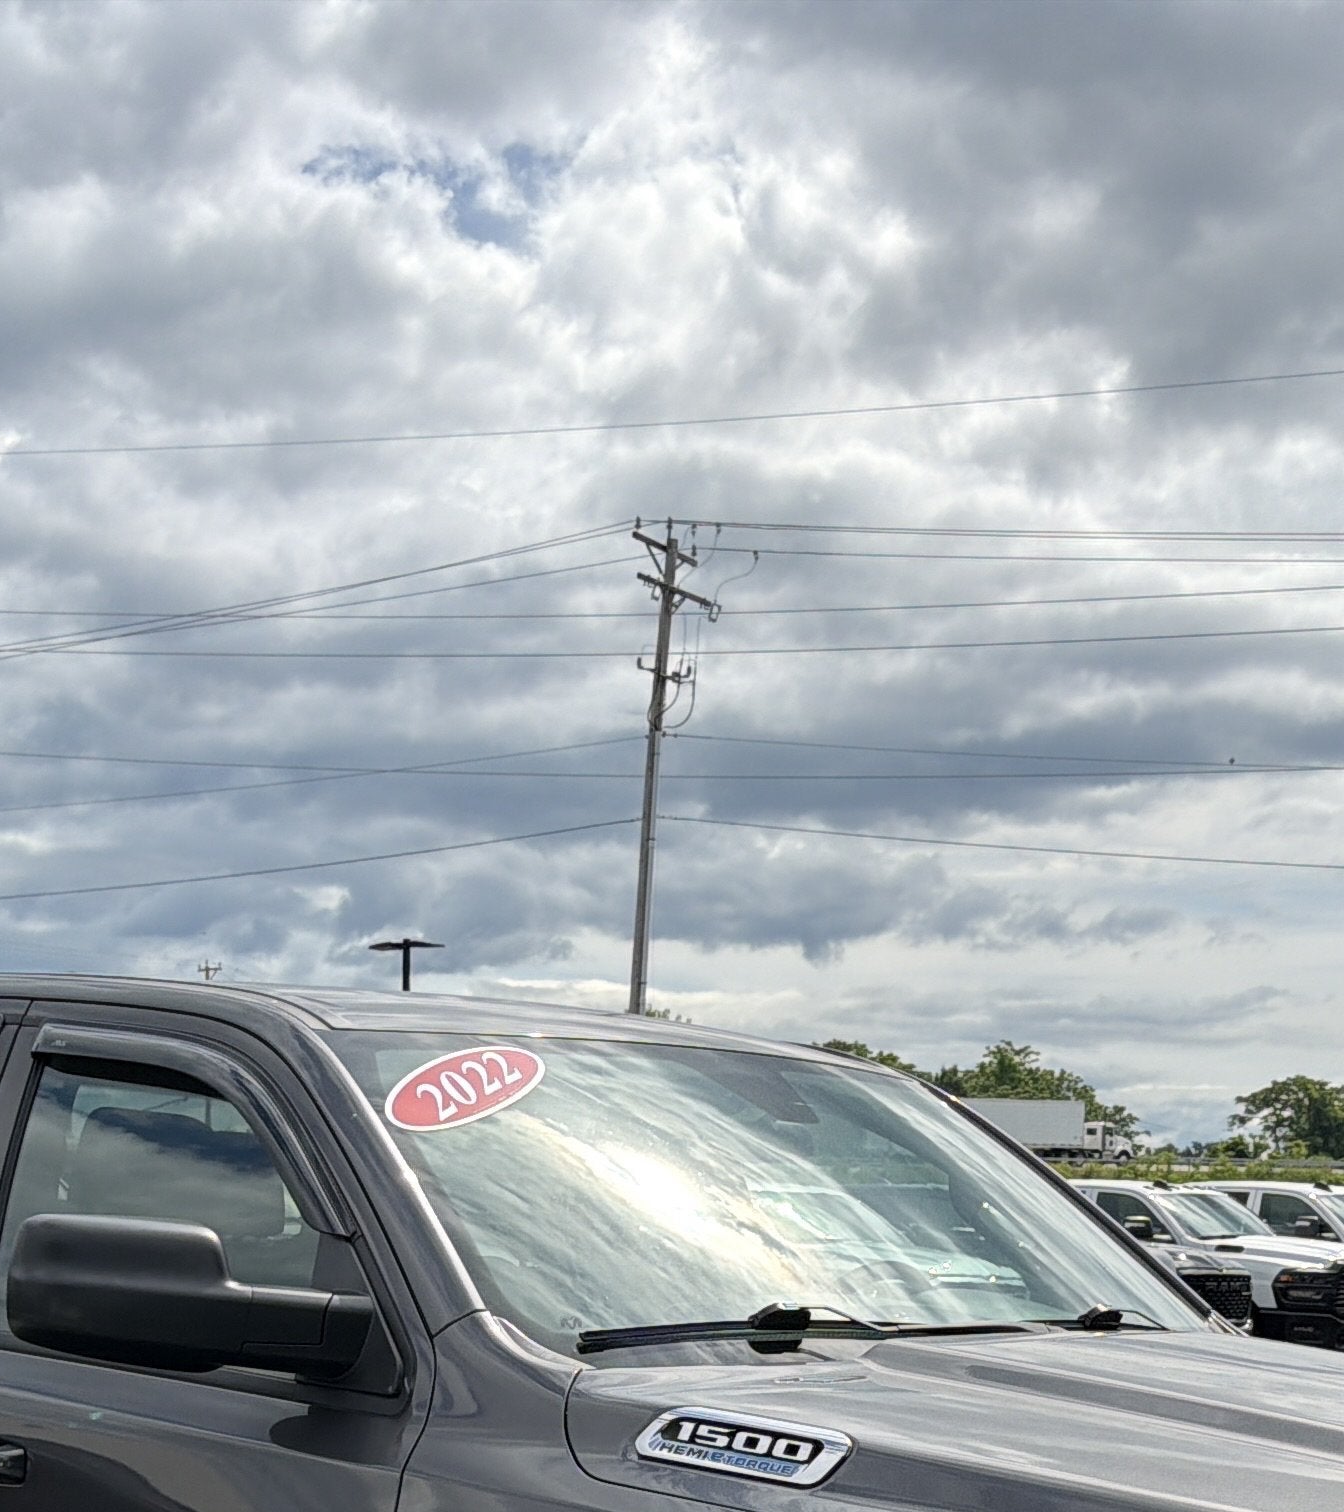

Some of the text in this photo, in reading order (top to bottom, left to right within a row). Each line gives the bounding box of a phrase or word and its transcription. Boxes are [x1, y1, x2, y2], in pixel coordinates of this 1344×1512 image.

[416, 1052, 523, 1121] 2022
[659, 1441, 708, 1460] HEMI
[677, 1421, 814, 1462] 1500
